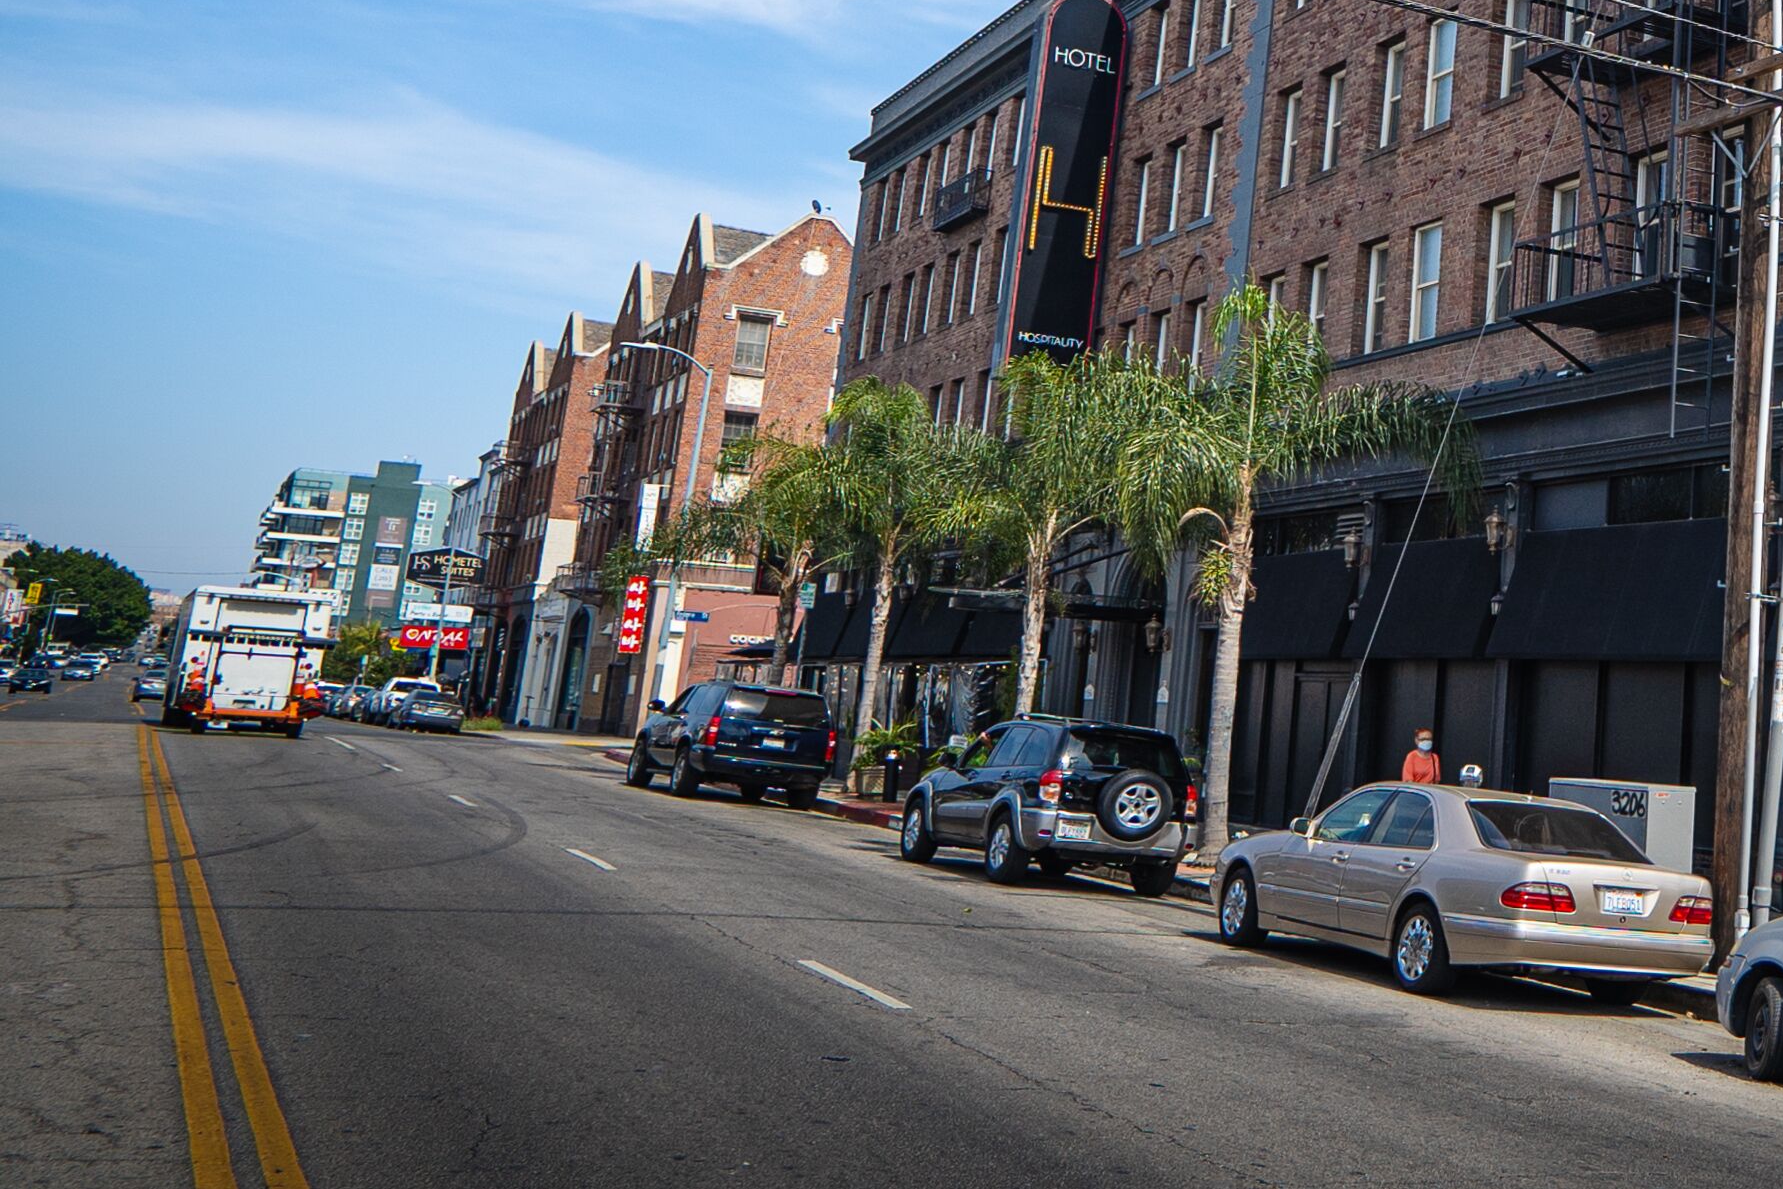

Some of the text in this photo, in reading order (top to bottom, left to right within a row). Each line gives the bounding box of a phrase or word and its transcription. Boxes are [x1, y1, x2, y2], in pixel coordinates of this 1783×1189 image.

[1054, 46, 1116, 74] HOTEL
[1029, 145, 1107, 258] H
[1018, 331, 1084, 349] HOSPITALITY
[433, 554, 482, 568] HOMETEL
[621, 580, 647, 648] 사바사바
[1612, 791, 1646, 817] 3206
